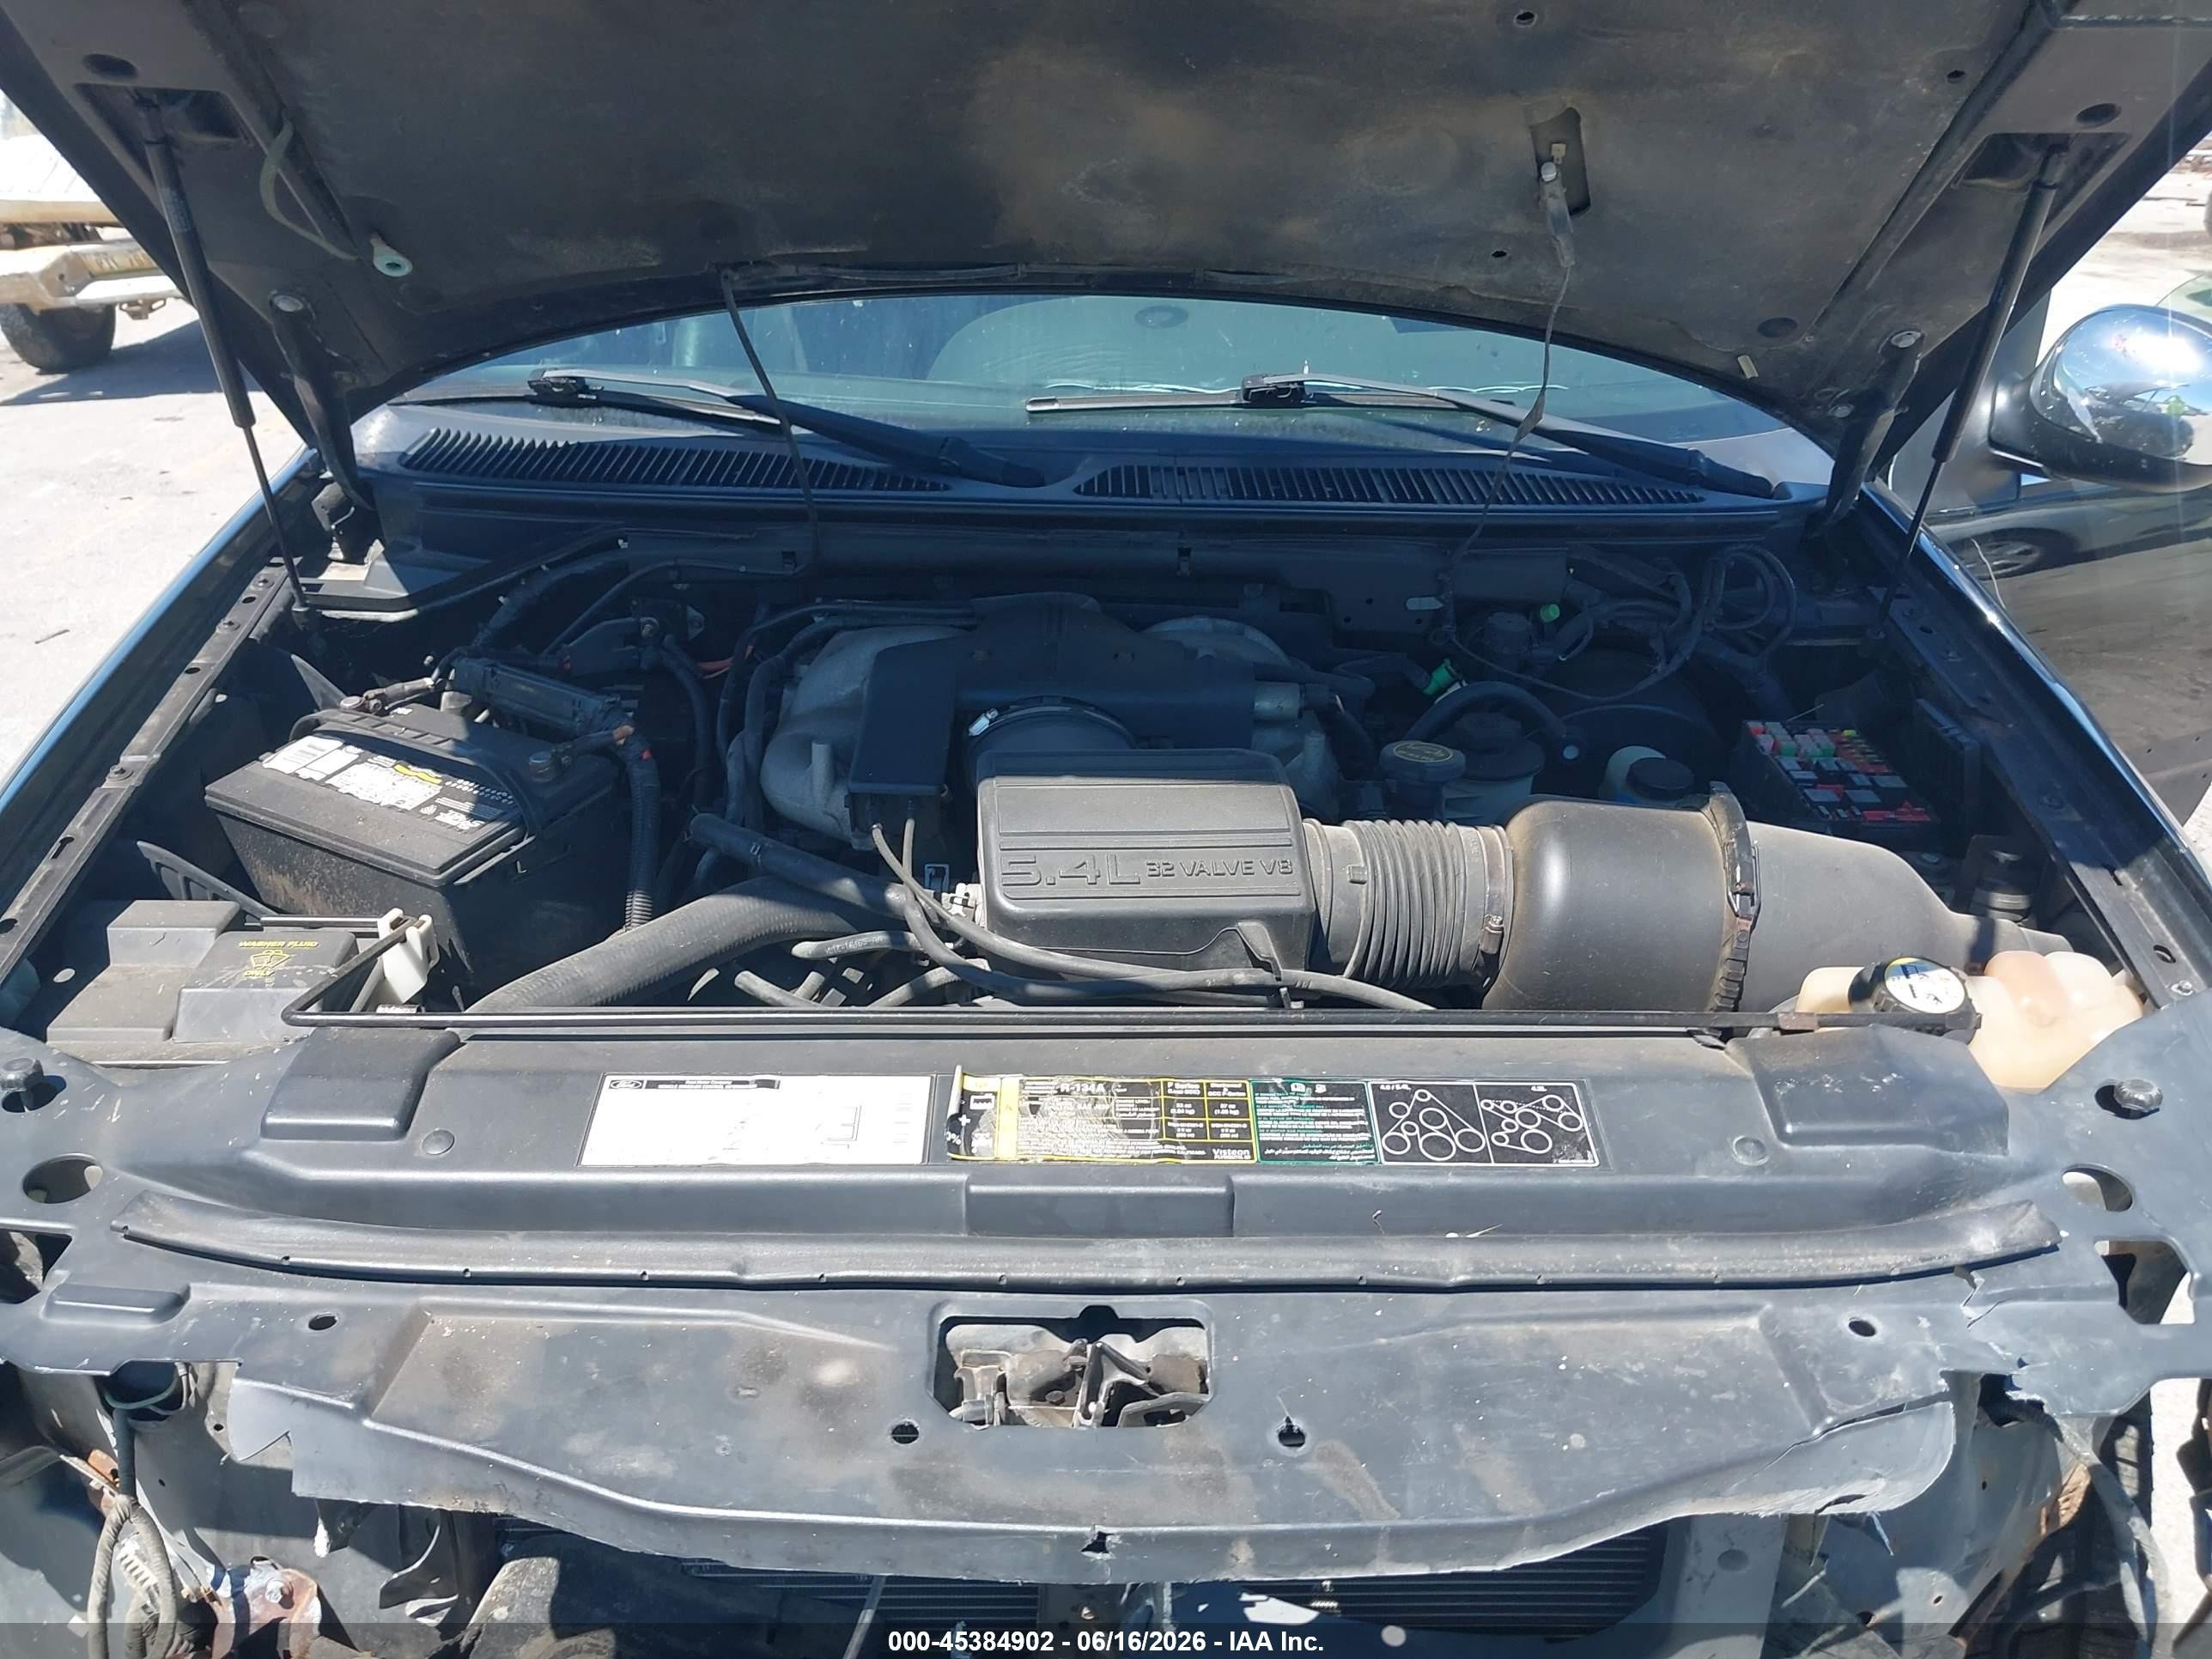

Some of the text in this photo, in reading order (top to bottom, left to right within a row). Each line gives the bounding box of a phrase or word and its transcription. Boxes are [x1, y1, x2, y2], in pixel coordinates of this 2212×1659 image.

[1000, 854, 1293, 887] 5.4L 32 VALVE V8
[1060, 1082, 1106, 1093] R-134A
